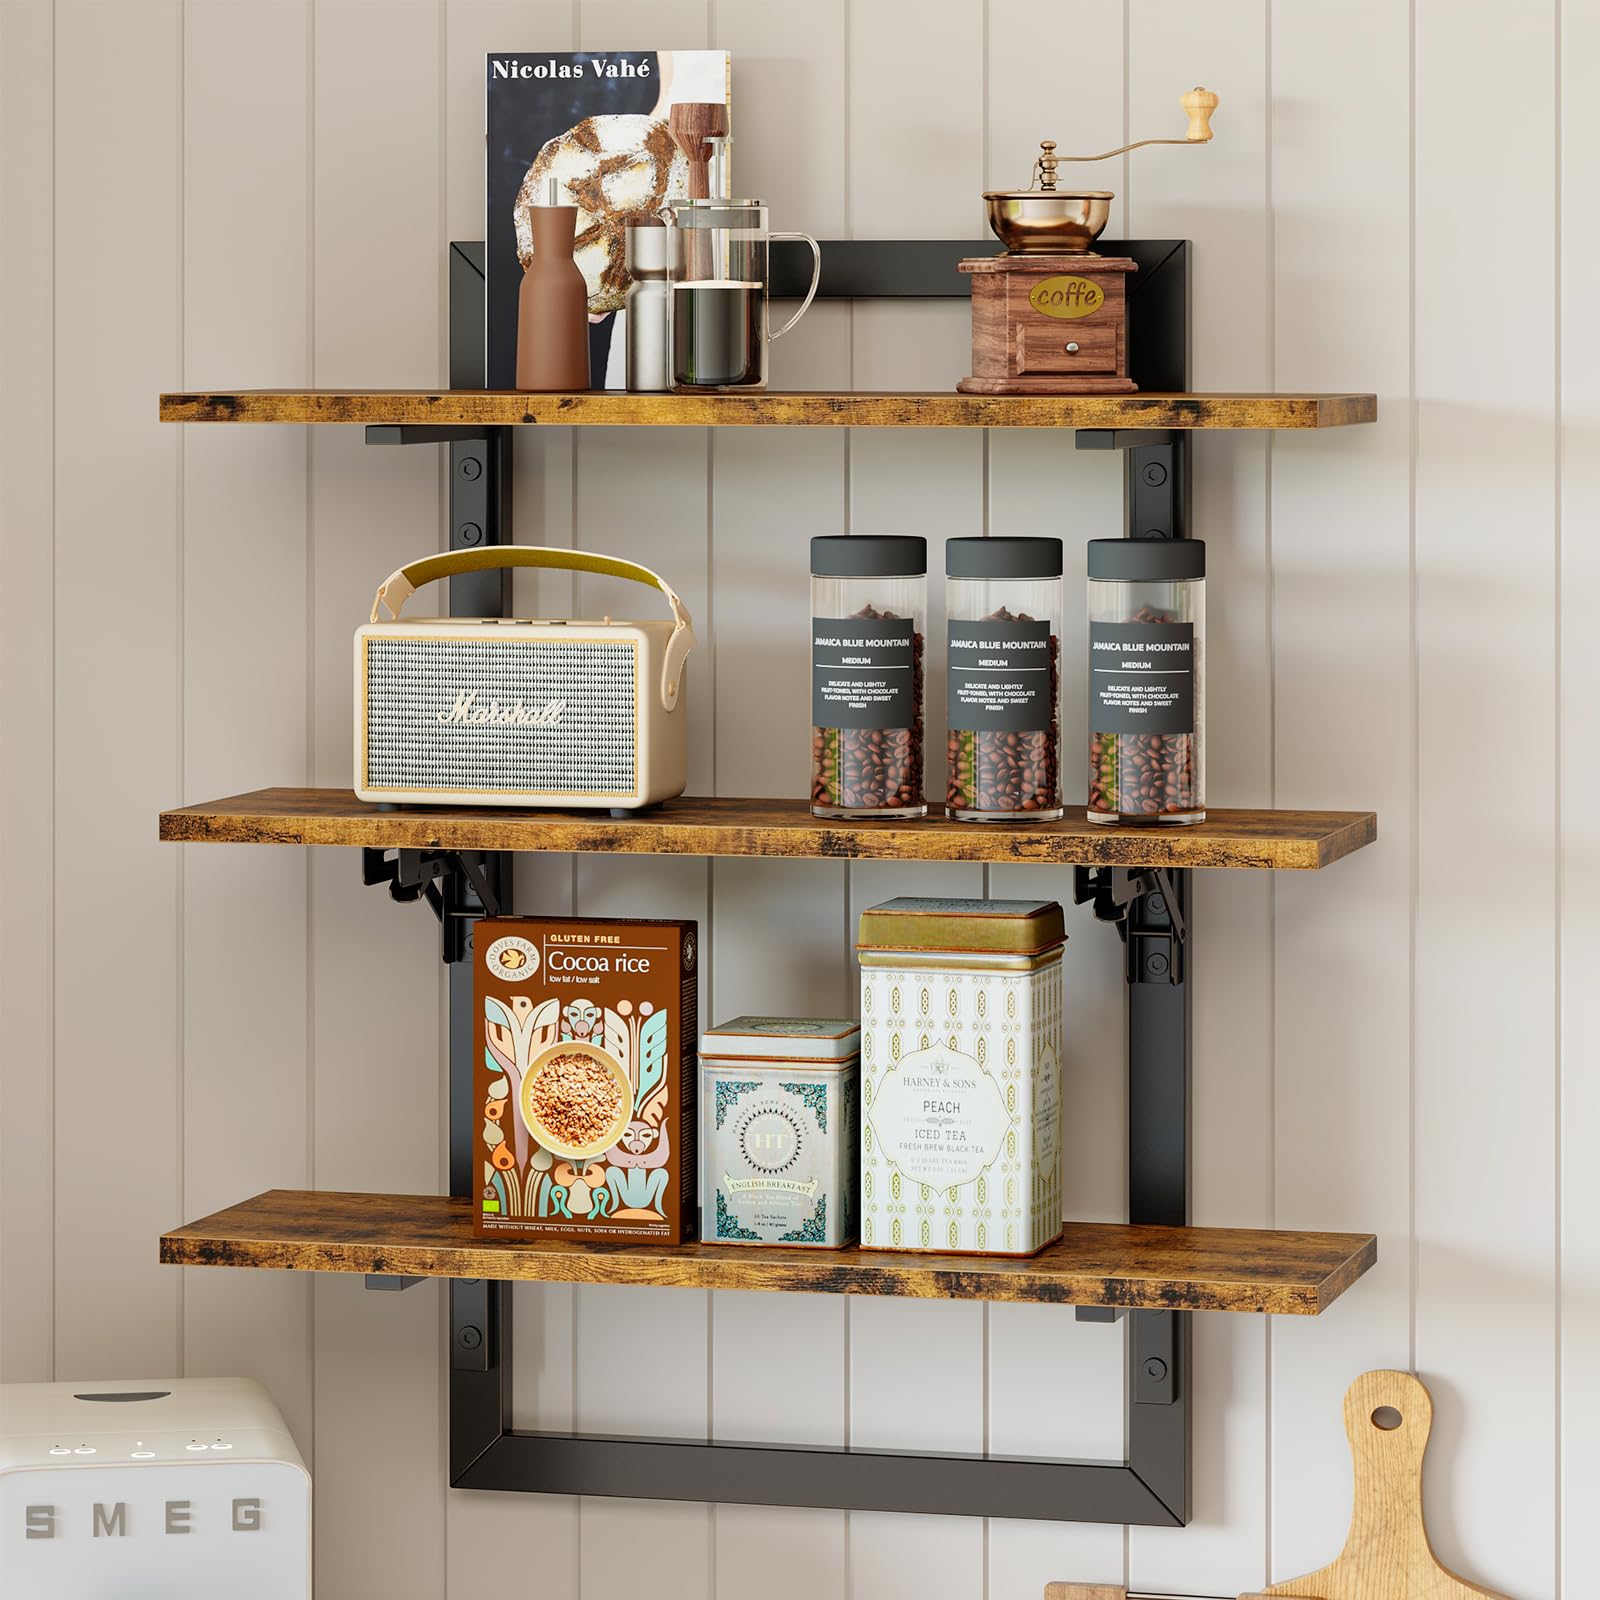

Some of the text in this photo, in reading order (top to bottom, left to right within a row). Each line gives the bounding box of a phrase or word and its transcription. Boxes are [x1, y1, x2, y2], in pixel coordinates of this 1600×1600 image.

[492, 58, 650, 78] Nicolas Vahé
[1038, 282, 1096, 306] coffe
[814, 638, 910, 648] JAMAICA BLUE MOUNTAIN
[950, 640, 1046, 649] JAMAICA BLUE MOUNTAIN
[1093, 642, 1190, 652] JAMAICA BLUE MOUNTAIN
[436, 689, 566, 725] Marshall
[550, 934, 620, 944] GLUTEN FREE
[489, 940, 536, 961] DOVES FARM
[548, 951, 650, 973] Cocoa rice
[492, 964, 533, 979] ORGANIC
[903, 1077, 941, 1087] HARNEY
[952, 1080, 976, 1088] SONS
[923, 1100, 960, 1114] PEACH
[915, 1129, 966, 1141] ICED TEA
[732, 1181, 811, 1193] ENGLISH BREAKFAST
[26, 1498, 260, 1539] SMEG
